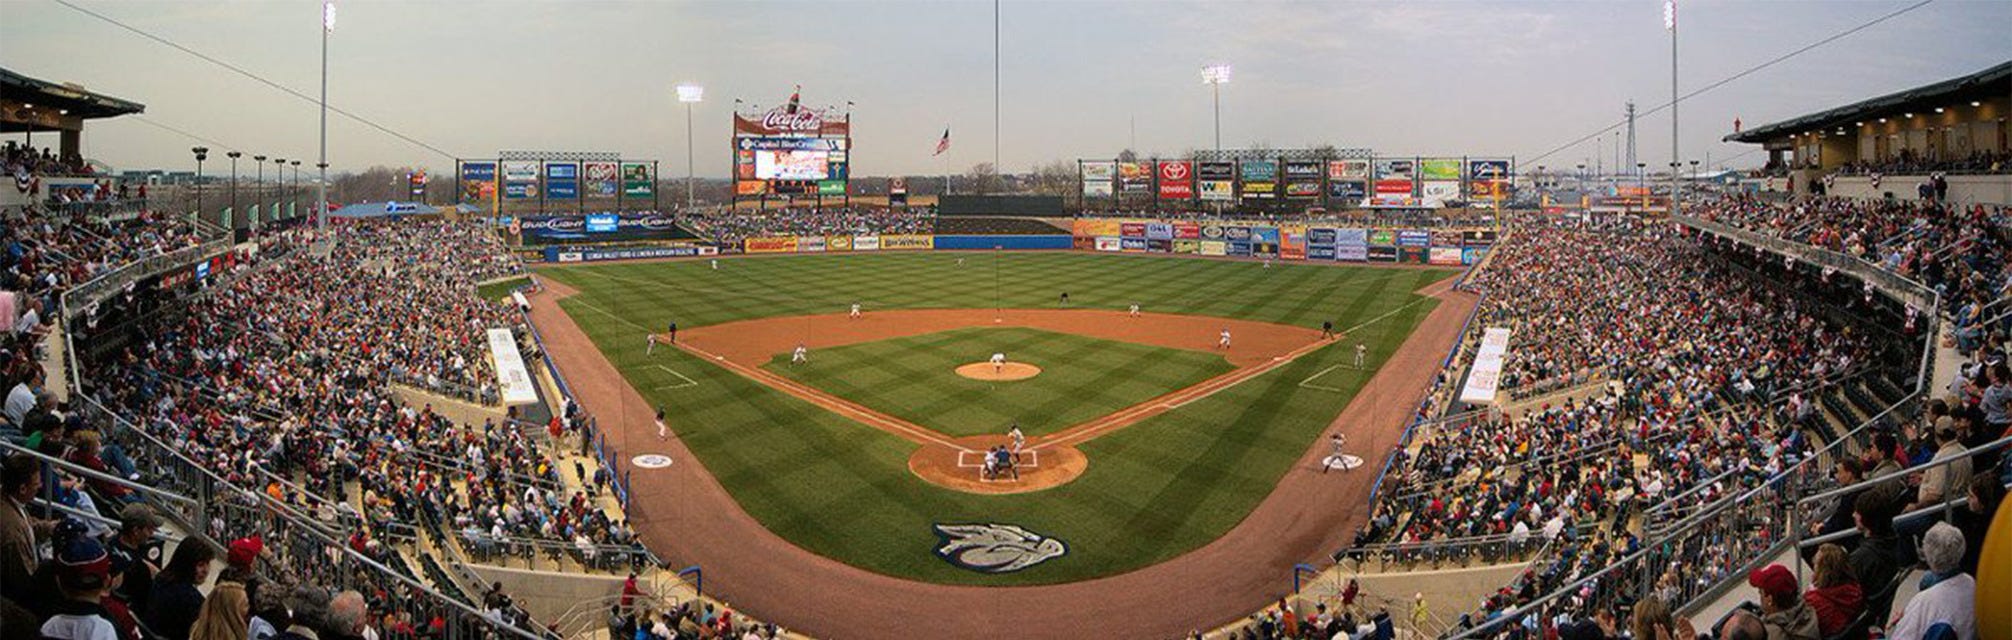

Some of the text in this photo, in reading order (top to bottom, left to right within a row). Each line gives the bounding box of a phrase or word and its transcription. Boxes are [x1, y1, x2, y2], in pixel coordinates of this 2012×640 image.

[1160, 185, 1192, 194] TOYOTA
[521, 220, 548, 229] BUD
[550, 219, 585, 229] LIGHT
[643, 217, 674, 226] LIGHT
